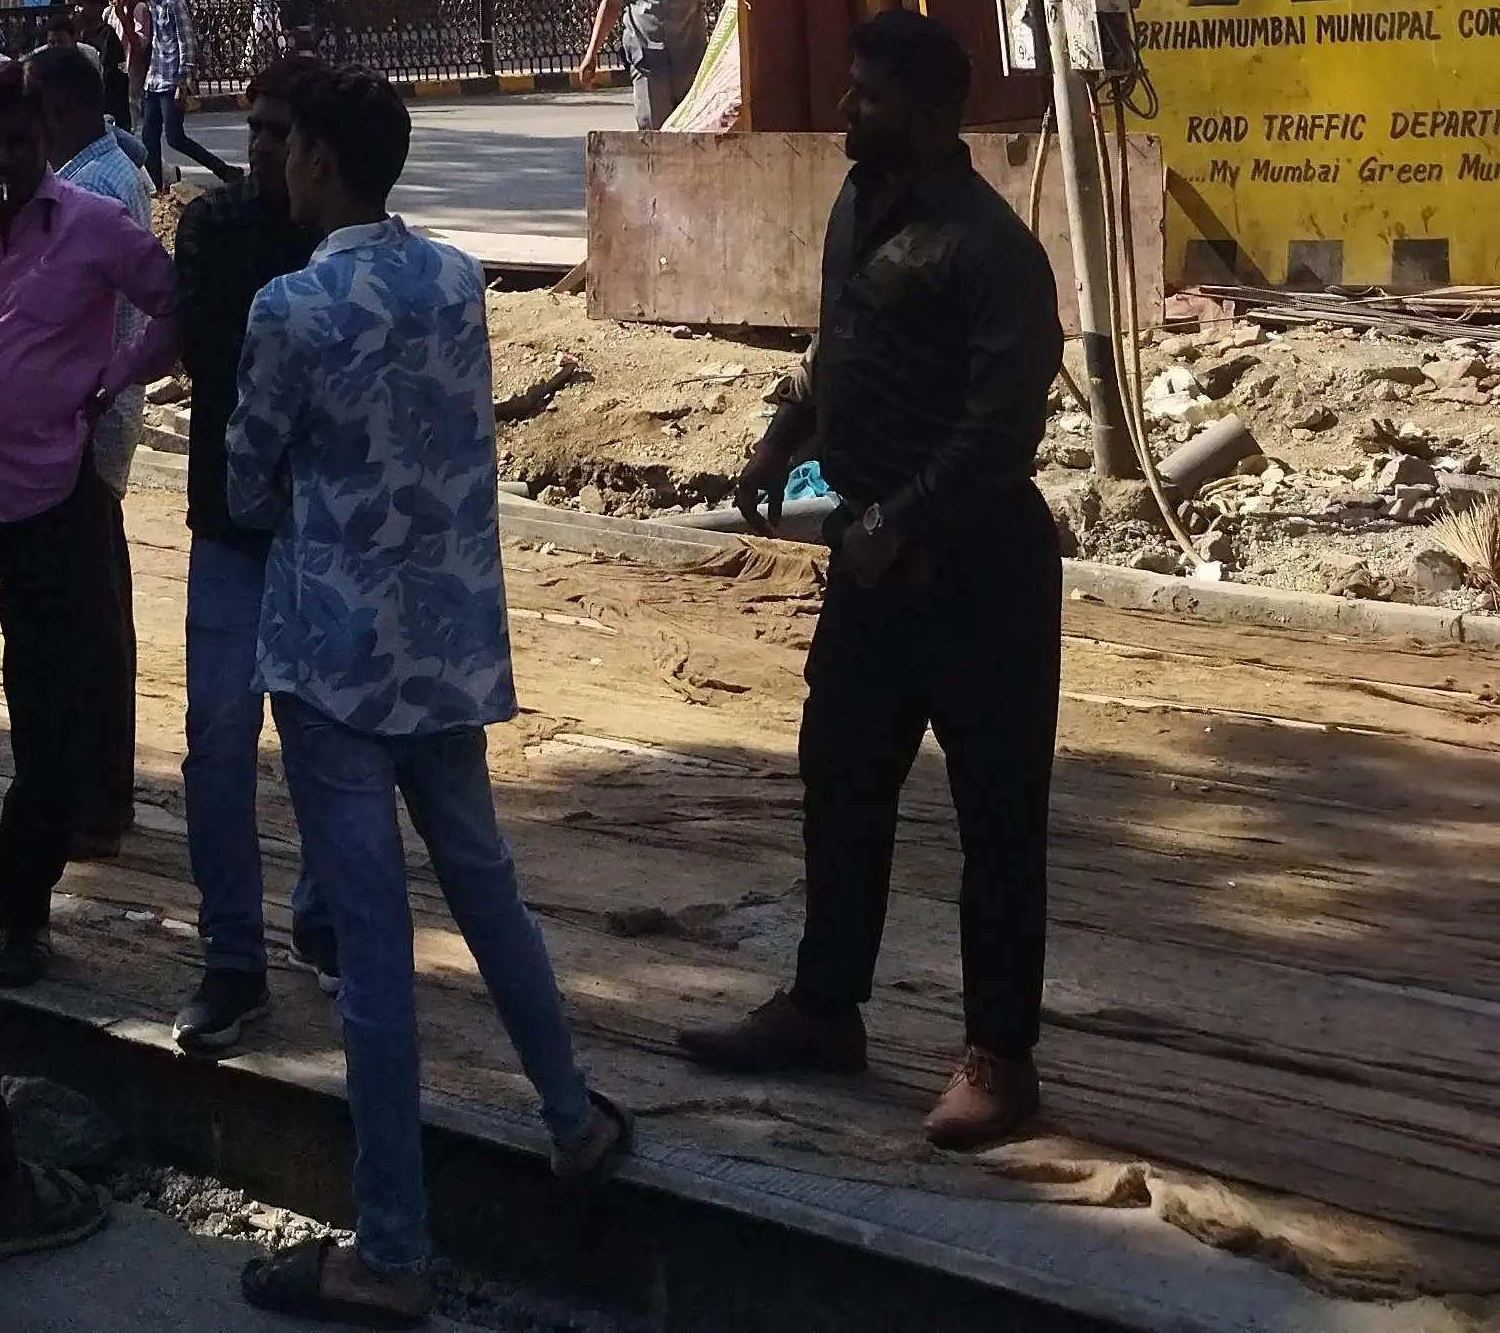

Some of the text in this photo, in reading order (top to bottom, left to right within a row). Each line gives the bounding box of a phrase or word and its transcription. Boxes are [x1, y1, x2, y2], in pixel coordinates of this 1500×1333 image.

[1136, 15, 1306, 50] BRIHANMUMBAI
[1316, 10, 1442, 44] MUNICIPAL
[1187, 115, 1249, 143] ROAD
[1263, 113, 1366, 141] TRAFFIC
[1251, 158, 1340, 183] Mumbai
[1358, 156, 1443, 183] Green
